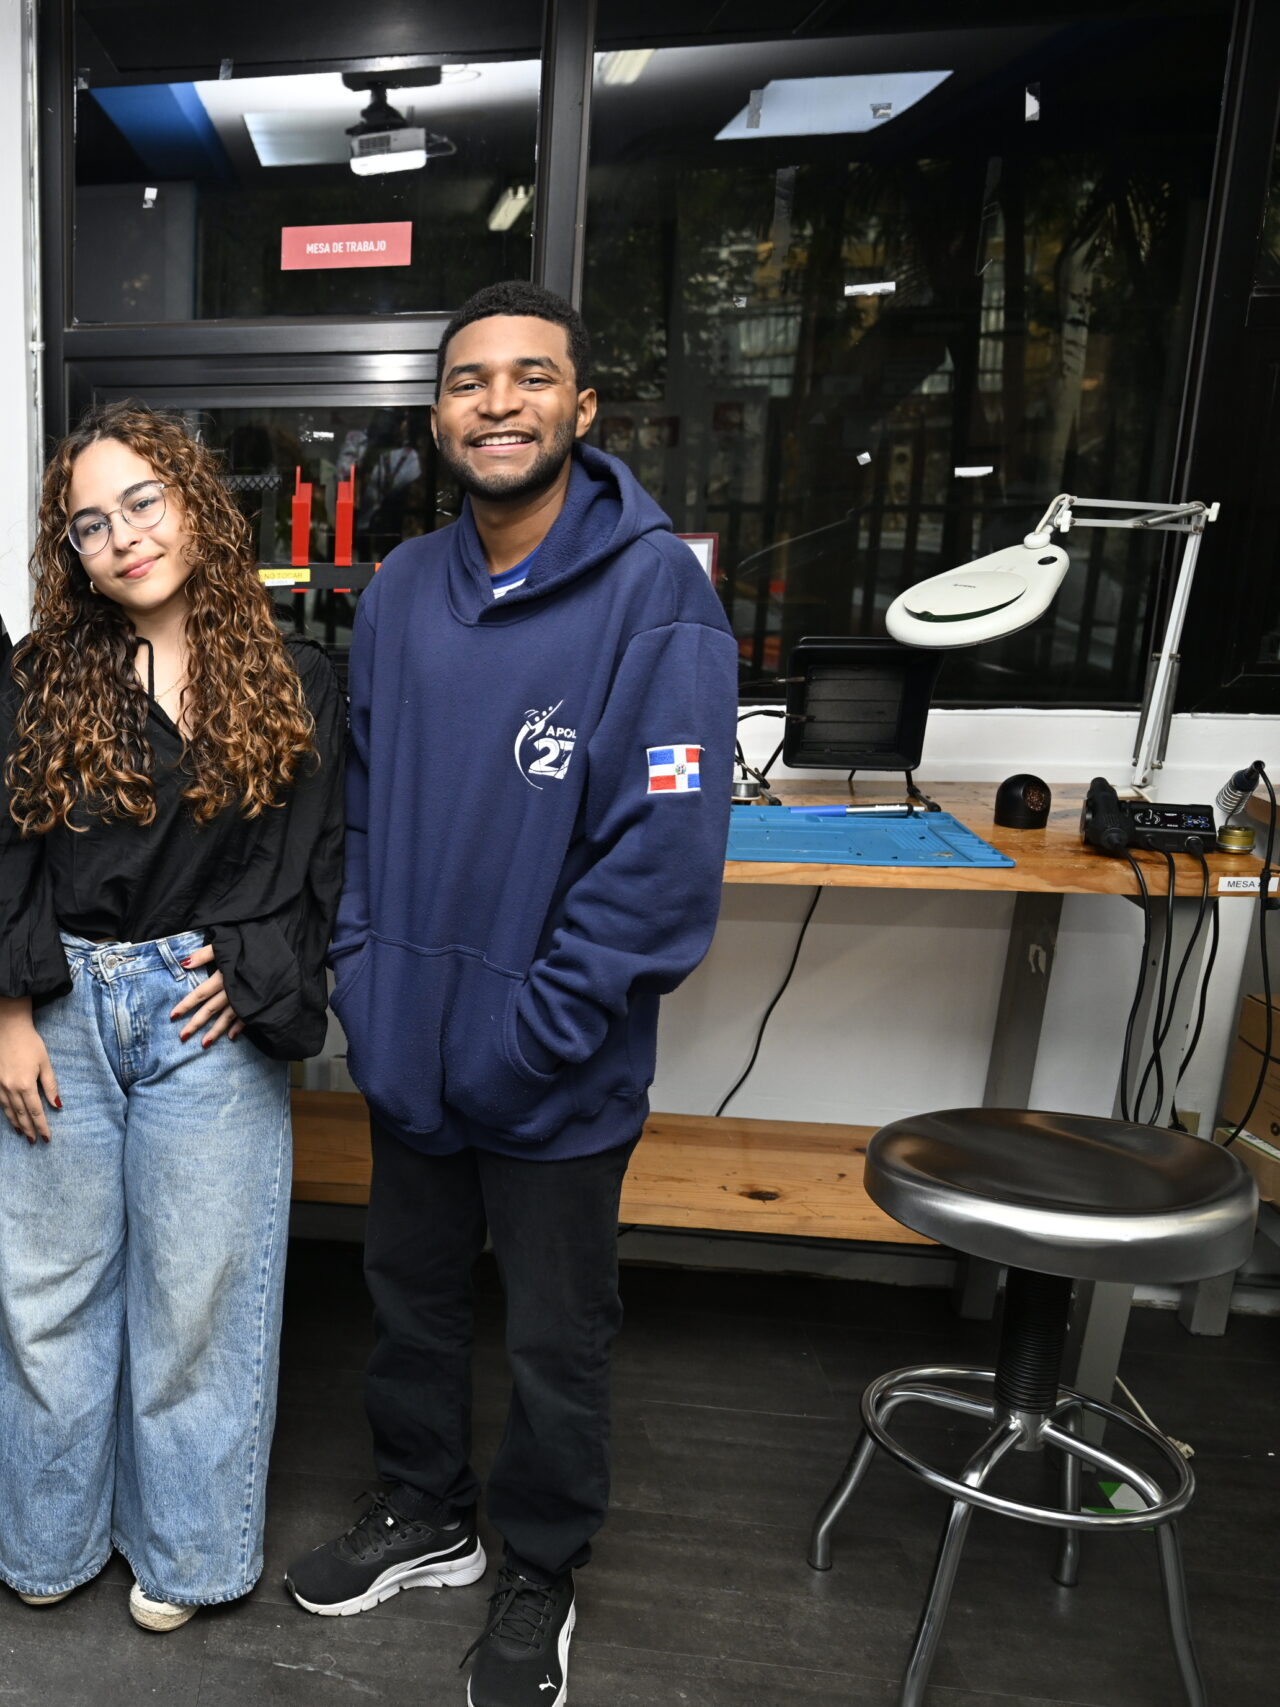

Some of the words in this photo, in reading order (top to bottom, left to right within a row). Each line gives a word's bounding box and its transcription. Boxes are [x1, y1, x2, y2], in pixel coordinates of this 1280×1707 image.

[306, 242, 330, 255] MESA
[332, 241, 343, 254] DE
[346, 240, 387, 252] TRABAJO
[545, 725, 577, 739] APOL
[1227, 880, 1256, 888] MESA
